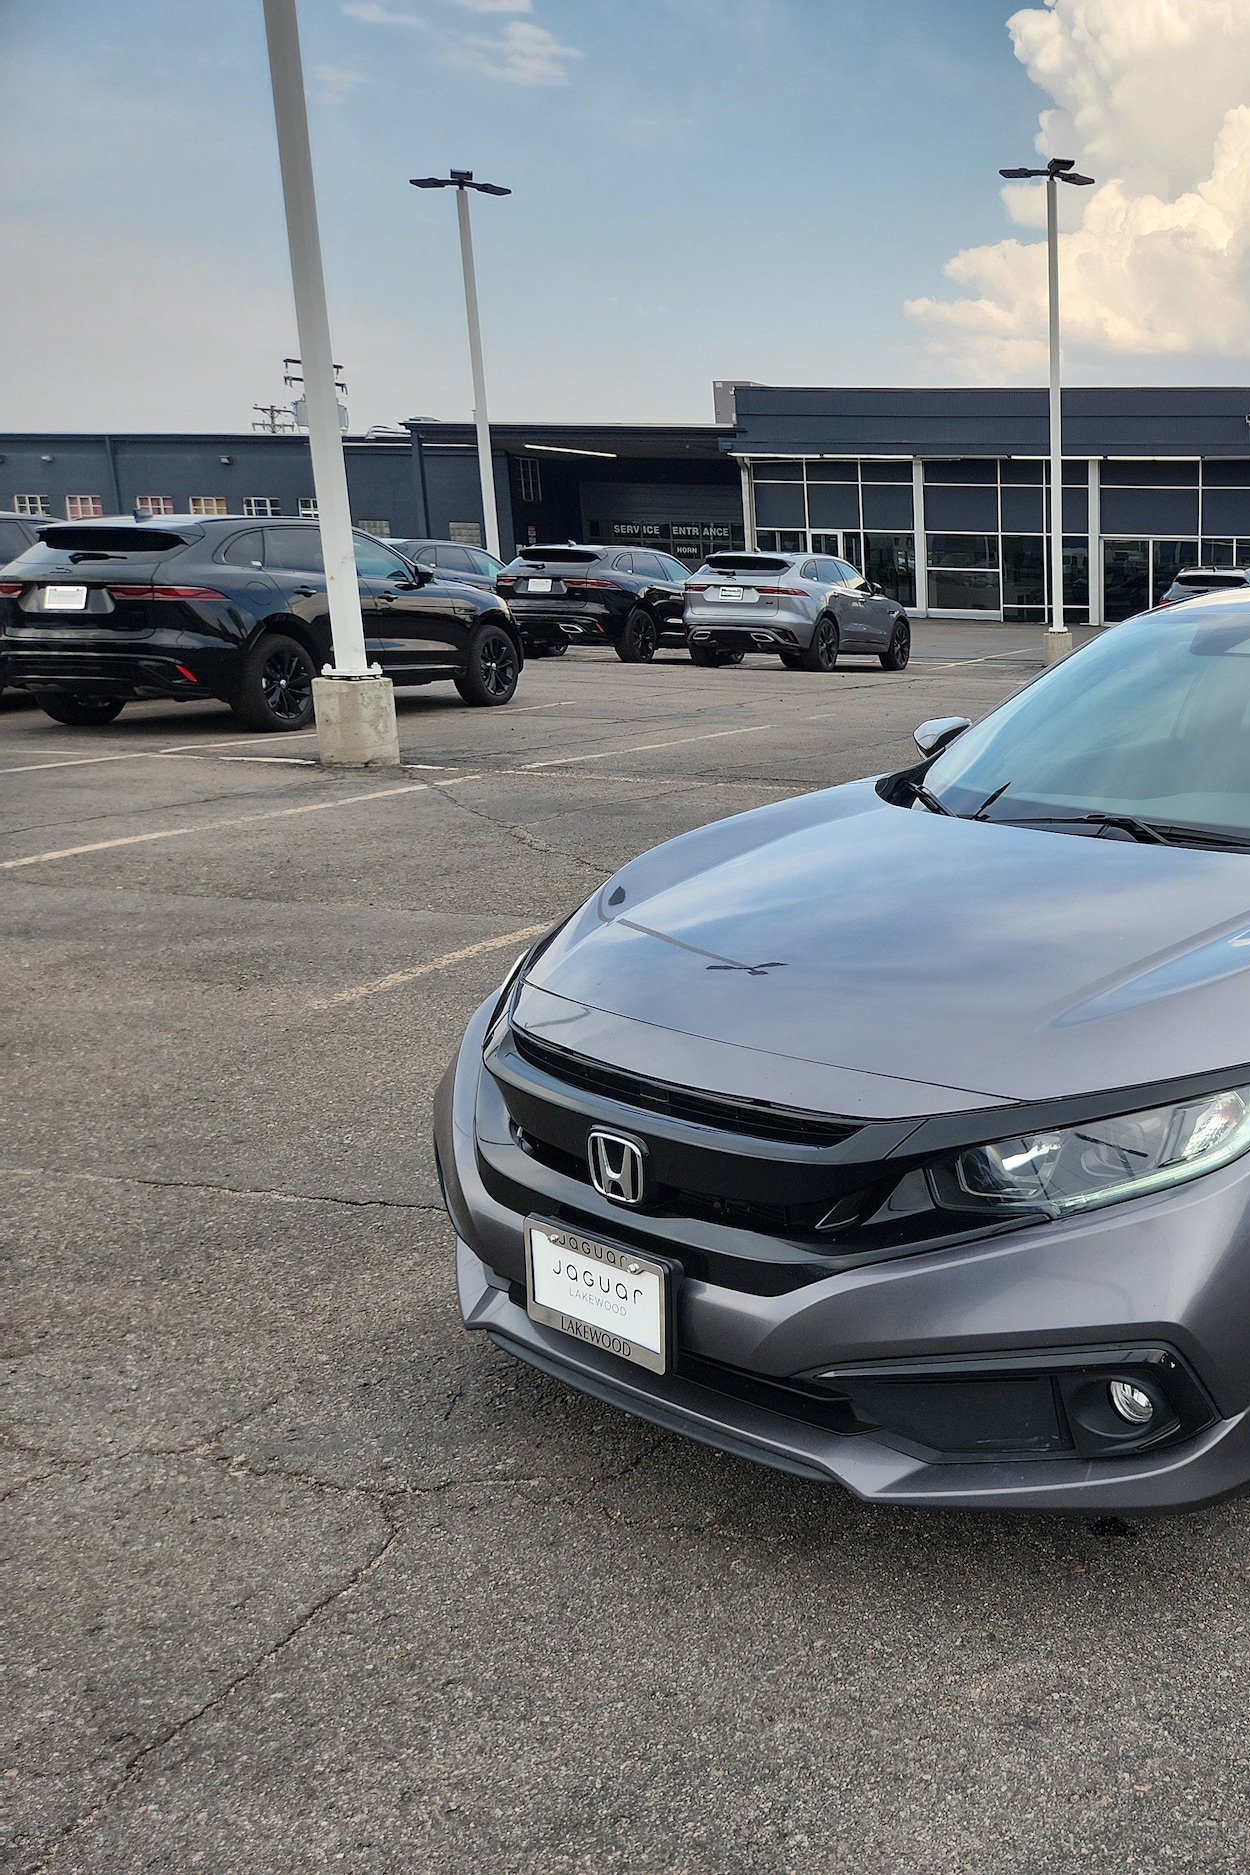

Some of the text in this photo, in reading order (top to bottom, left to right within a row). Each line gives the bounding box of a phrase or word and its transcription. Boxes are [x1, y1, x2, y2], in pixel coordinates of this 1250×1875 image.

[614, 525, 729, 536] SERVICE ENTRANCE
[568, 1286, 627, 1317] LAKEWOOD
[560, 1316, 632, 1358] LAKEWOOD
